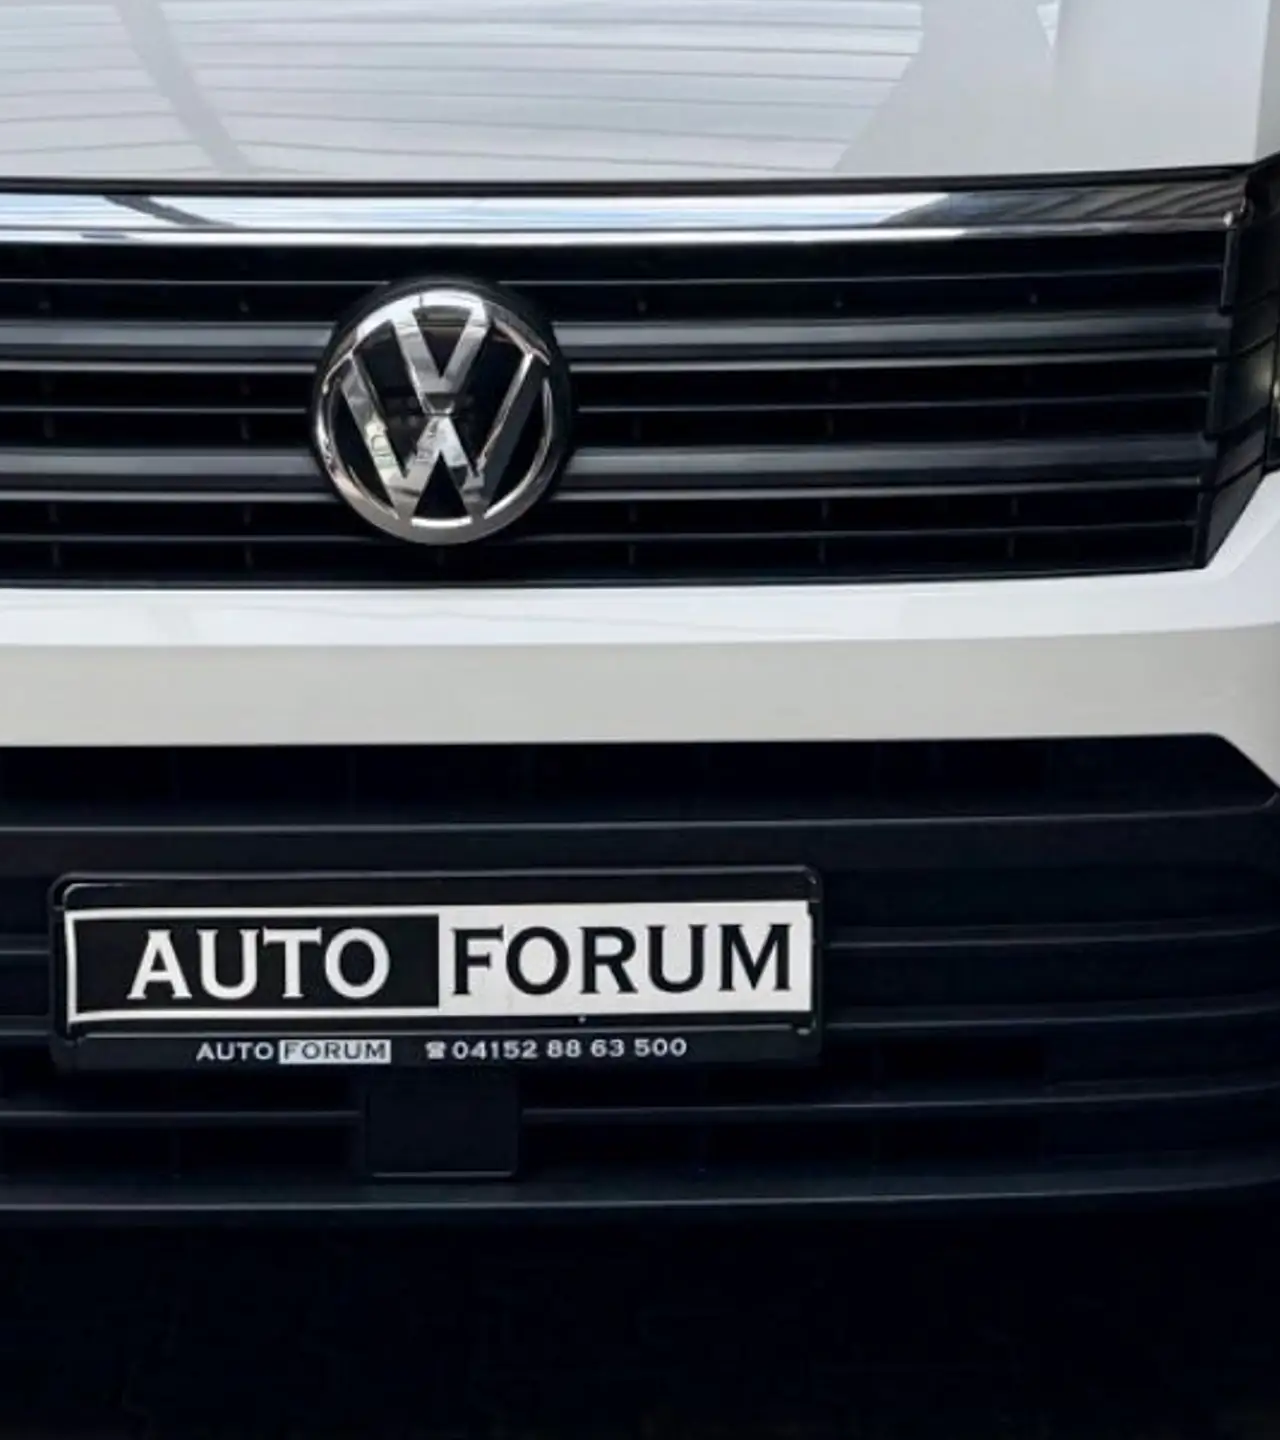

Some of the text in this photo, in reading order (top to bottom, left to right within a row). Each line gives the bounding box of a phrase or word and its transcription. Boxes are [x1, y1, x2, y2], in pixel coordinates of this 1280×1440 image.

[127, 923, 792, 1001] AUTO FORUM
[195, 1037, 688, 1062] AUTO FORUM 04152 88 63 500
